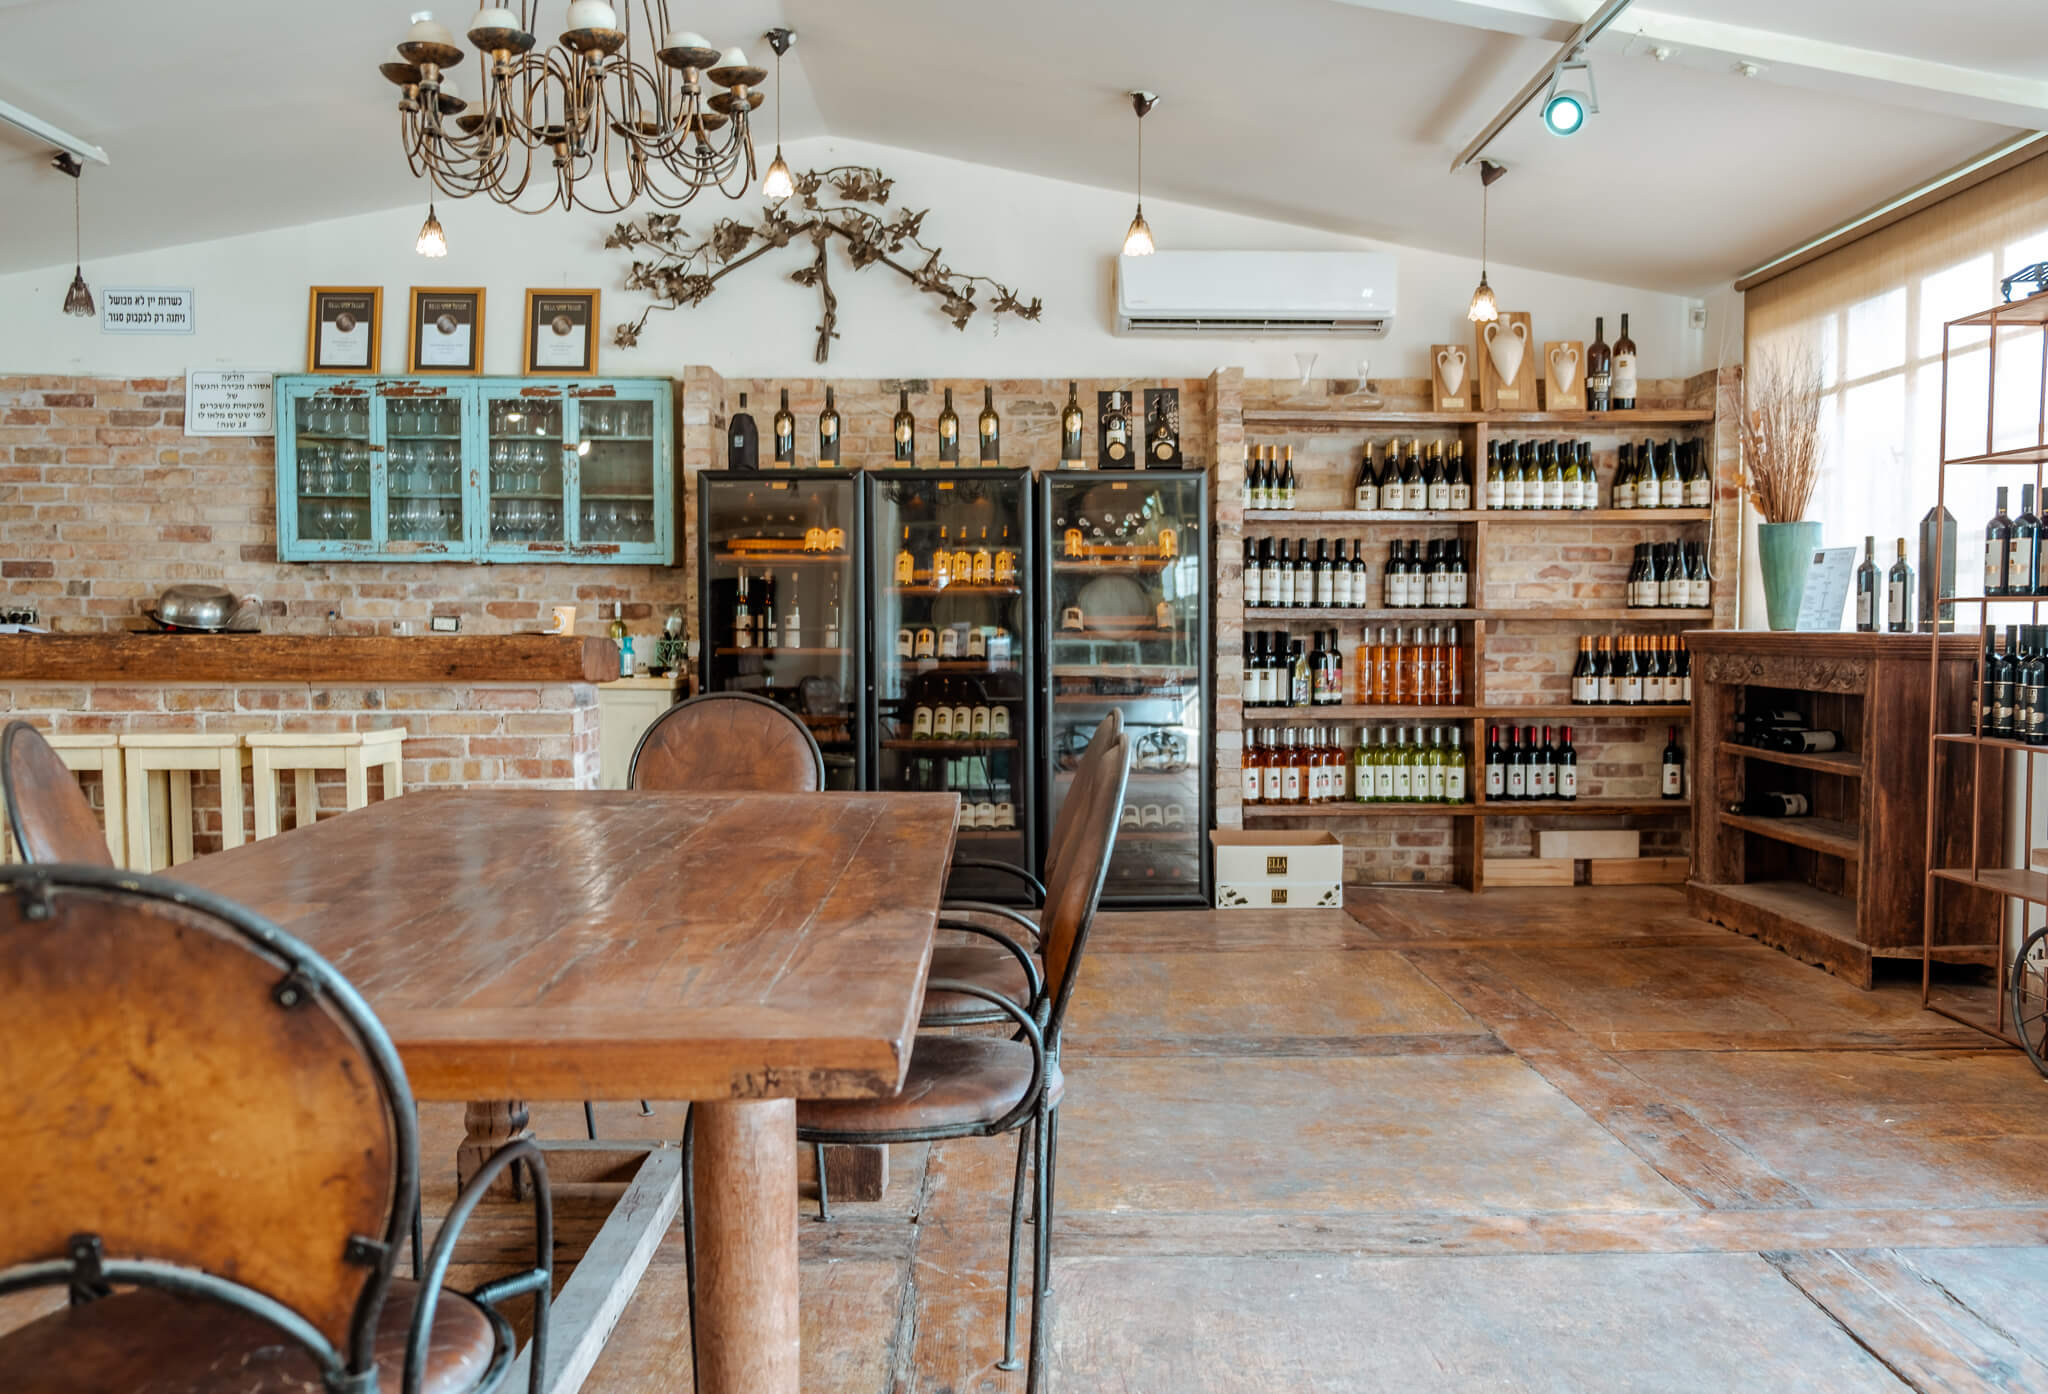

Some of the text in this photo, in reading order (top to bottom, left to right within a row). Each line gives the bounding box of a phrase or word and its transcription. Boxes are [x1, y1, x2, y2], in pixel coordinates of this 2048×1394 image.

[108, 294, 182, 308] כשרות יין לא מבושל
[126, 311, 152, 324] לבקבוק
[154, 312, 164, 324] רק
[166, 312, 186, 323] ניתנה
[226, 392, 238, 400] של
[1268, 857, 1287, 868] ELLA
